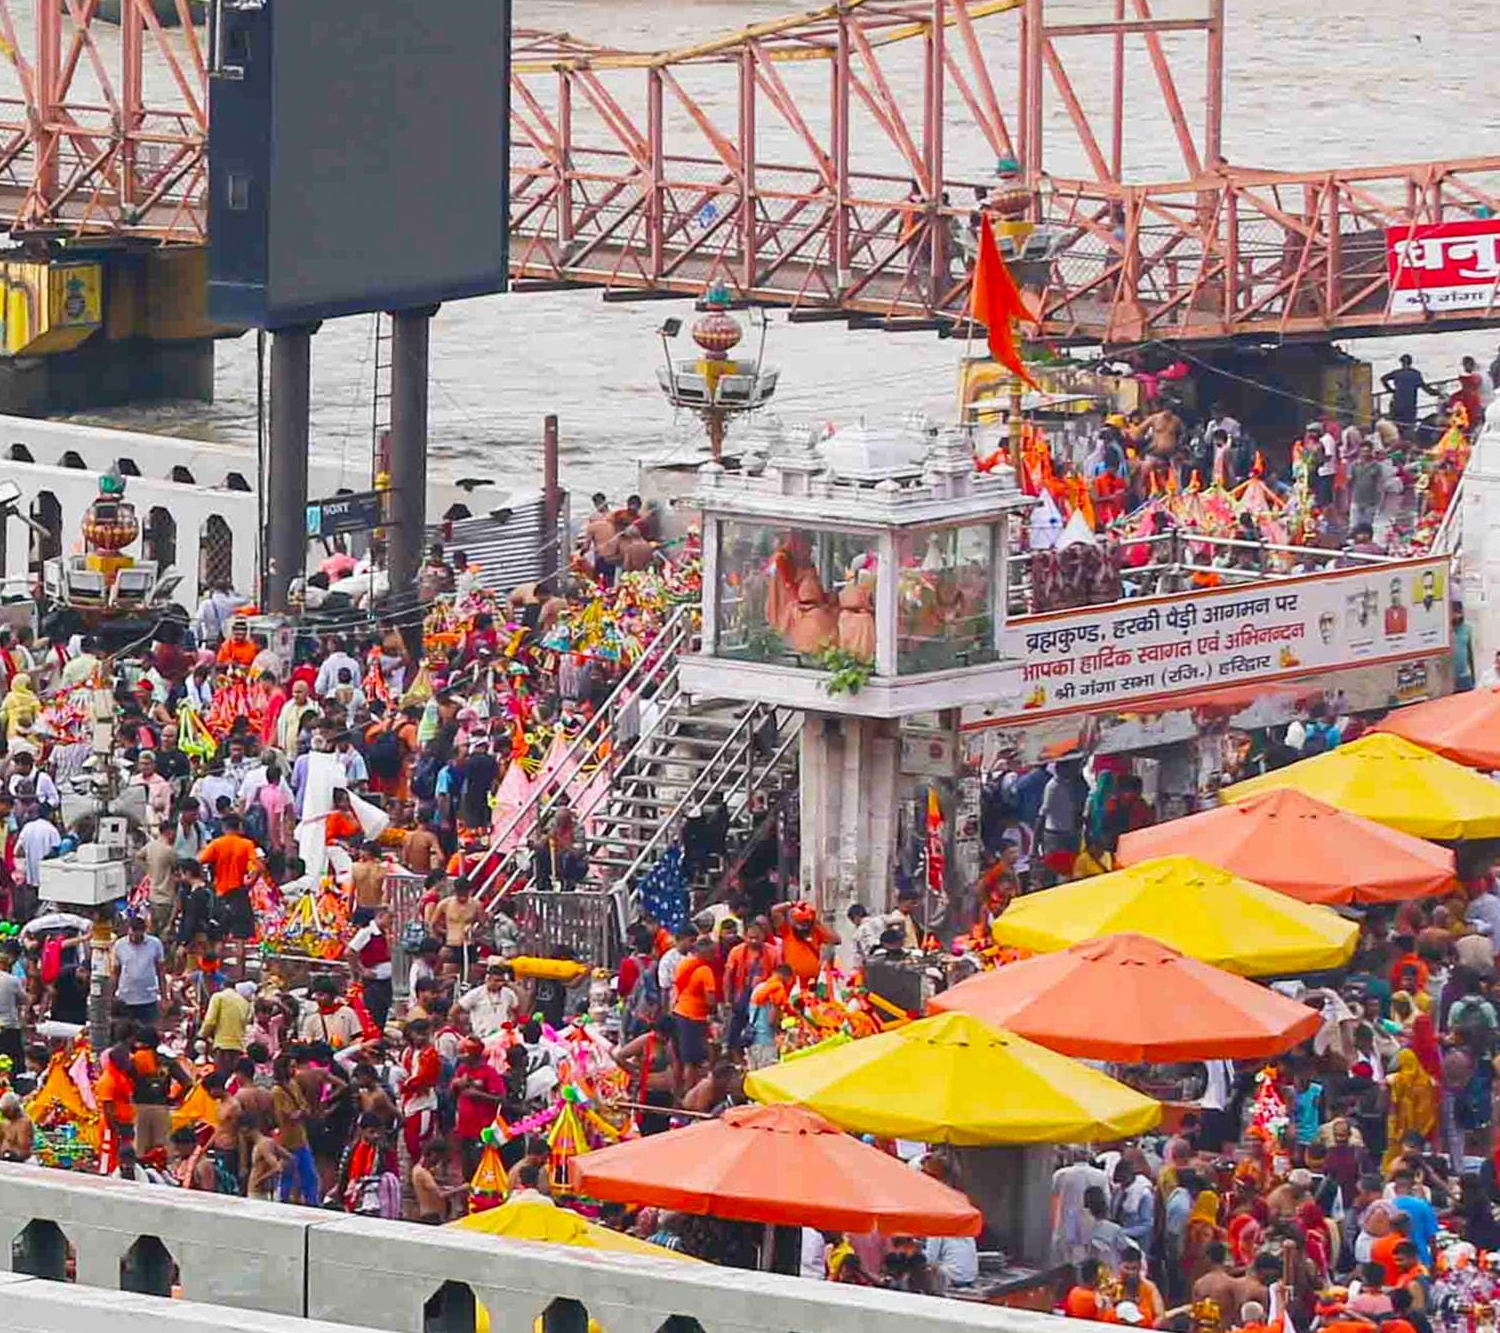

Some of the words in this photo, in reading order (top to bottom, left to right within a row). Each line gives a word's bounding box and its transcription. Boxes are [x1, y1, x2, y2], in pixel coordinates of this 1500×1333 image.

[1394, 233, 1500, 279] धनु
[1112, 609, 1160, 638] हरकी
[1202, 597, 1270, 623] आगमन
[1275, 594, 1298, 613] पर
[1080, 644, 1132, 674] हार्दिक
[1137, 640, 1192, 665] स्वागत
[1197, 630, 1219, 655] एवं
[1224, 621, 1305, 650] अभिनन्दन
[1054, 681, 1075, 700] श्री
[1080, 679, 1116, 696] गंगा
[1121, 673, 1154, 692] सभा
[1219, 654, 1271, 676] हरिद्वार
